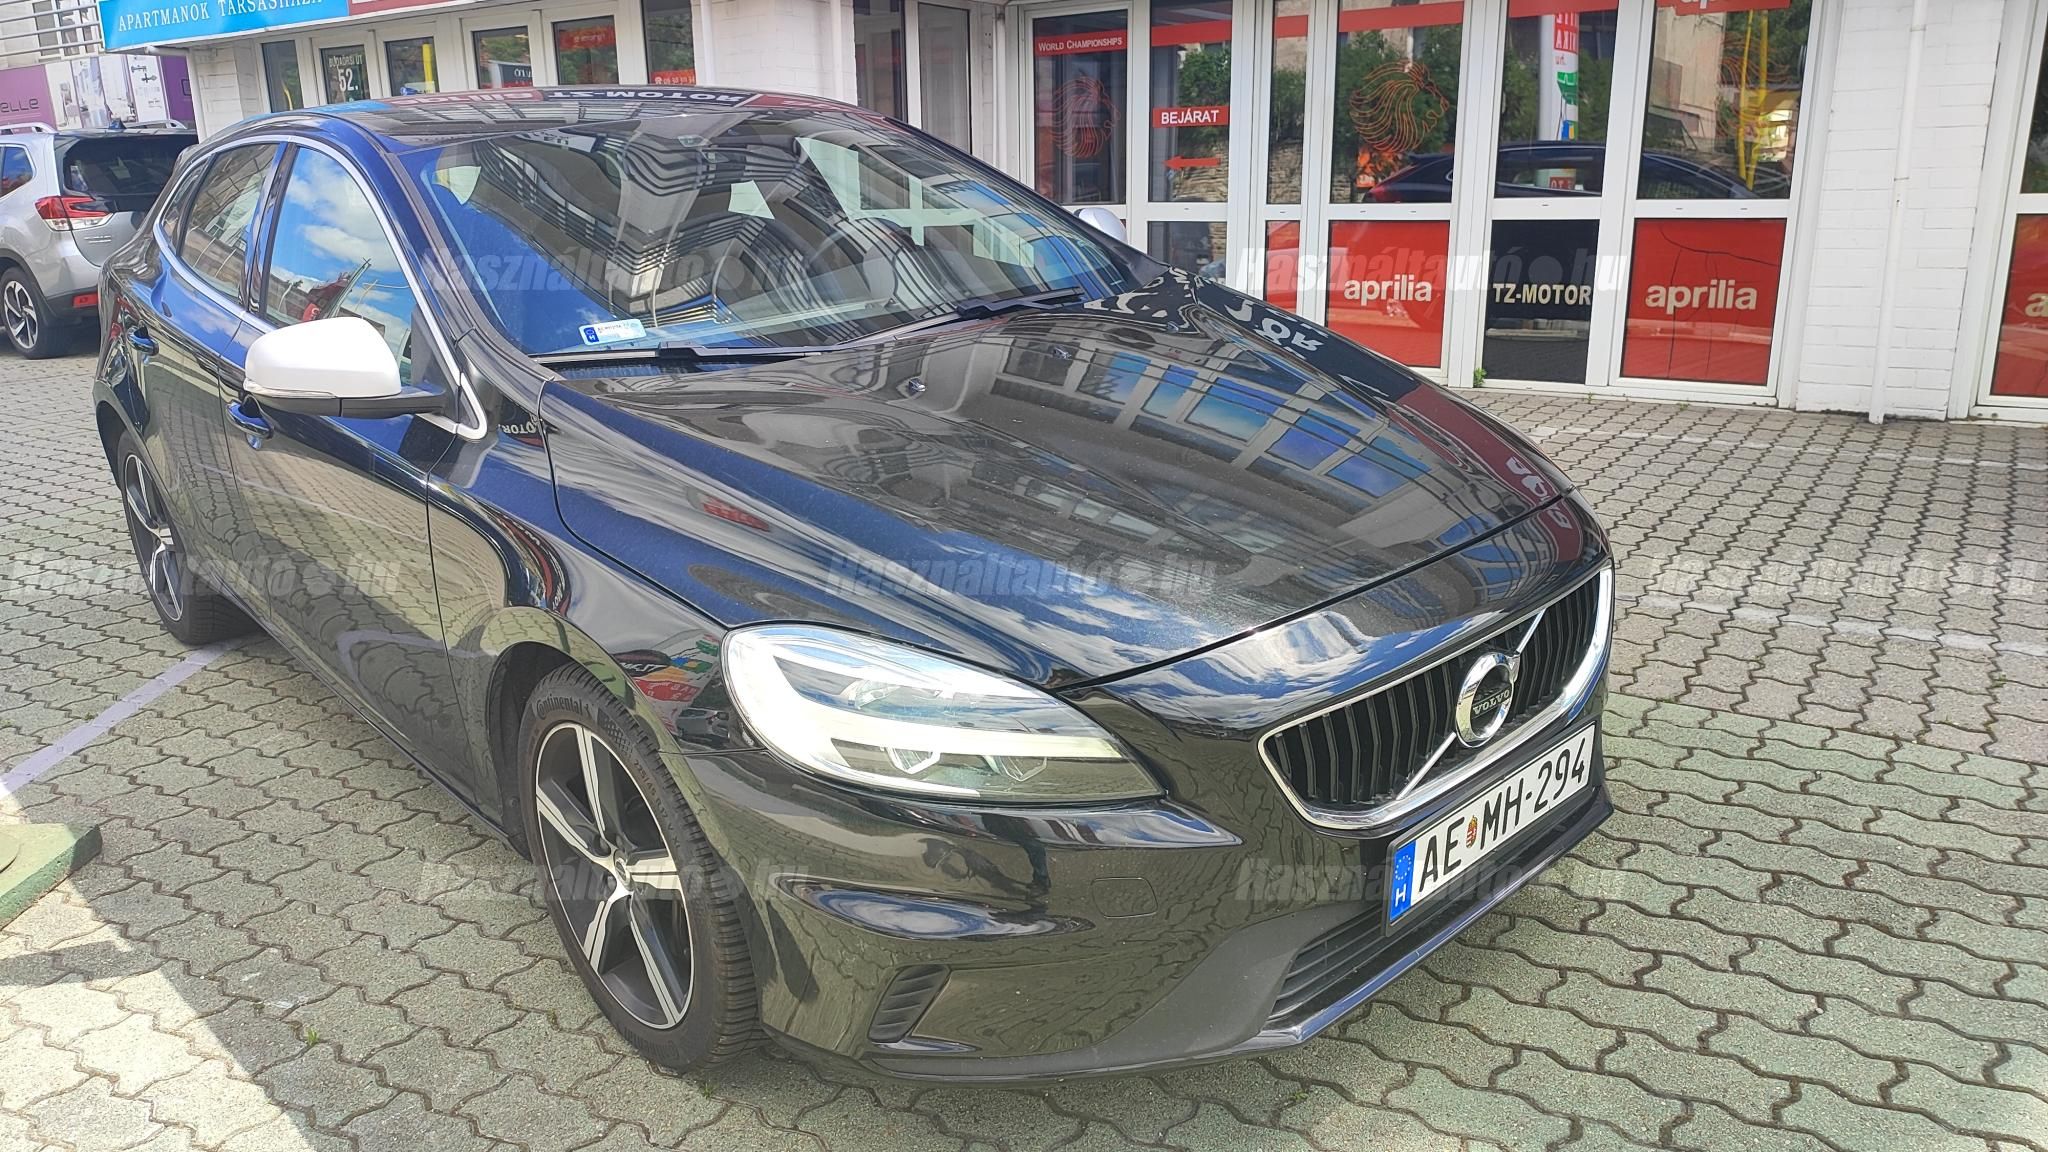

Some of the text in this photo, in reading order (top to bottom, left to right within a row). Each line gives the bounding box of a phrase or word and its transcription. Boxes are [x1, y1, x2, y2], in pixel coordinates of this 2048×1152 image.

[118, 2, 210, 32] APARTMANOK
[337, 68, 359, 92] 52.
[1161, 108, 1220, 125] BEJÁRAT
[1343, 273, 1433, 306] aprilia
[1492, 283, 1592, 305] TZ-MOTOR
[1645, 279, 1758, 314] aprilia
[536, 692, 583, 720] Continental
[1472, 689, 1510, 715] VOLVO
[1418, 737, 1587, 893] AE MH-294
[1394, 884, 1407, 908] H
